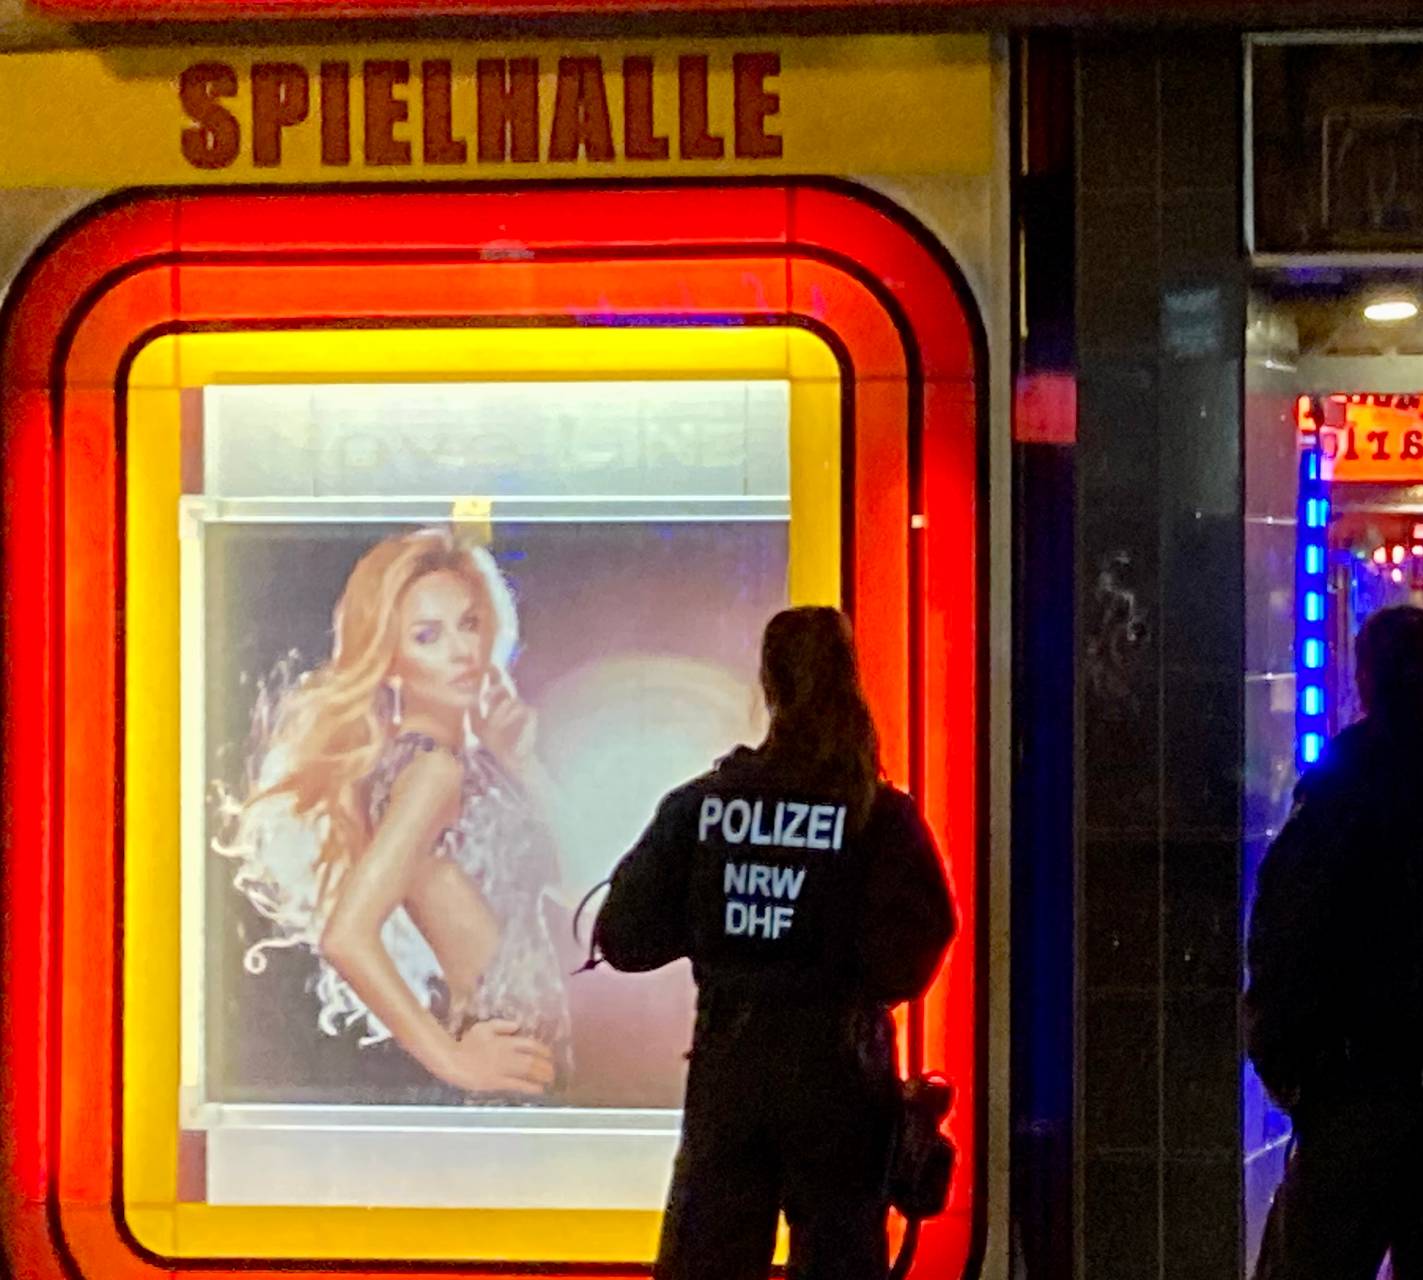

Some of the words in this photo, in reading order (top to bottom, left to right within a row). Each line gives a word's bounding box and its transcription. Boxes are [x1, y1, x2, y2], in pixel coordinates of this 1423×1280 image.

[178, 53, 784, 169] SPIELHALLE
[699, 798, 847, 850] POLIZEI
[723, 861, 805, 900] NRW
[724, 902, 795, 940] DHF
